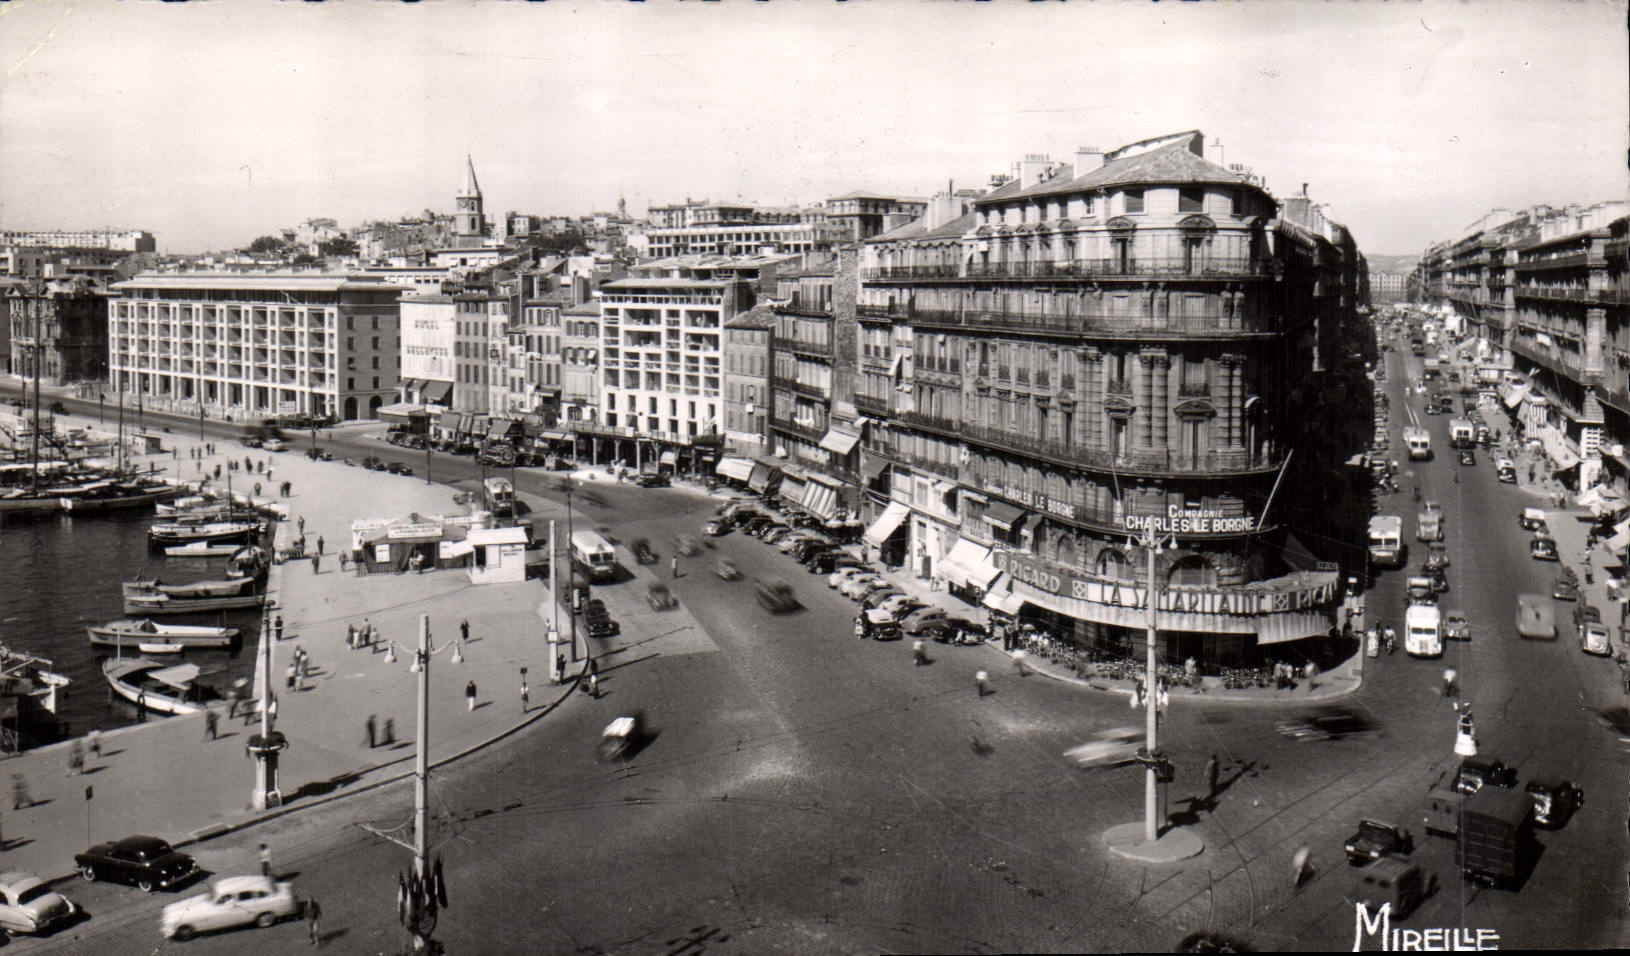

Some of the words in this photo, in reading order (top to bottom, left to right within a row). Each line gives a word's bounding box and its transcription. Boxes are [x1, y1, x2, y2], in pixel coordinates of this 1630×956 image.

[1034, 493, 1046, 510] LE
[1047, 499, 1075, 519] BORGNE
[1168, 504, 1225, 519] COMPAGNIE
[1126, 515, 1190, 533] CHARLES
[1193, 518, 1210, 533] LE
[1212, 516, 1255, 532] BORGNE
[1010, 559, 1060, 593] RICARD
[1101, 580, 1122, 607] LA
